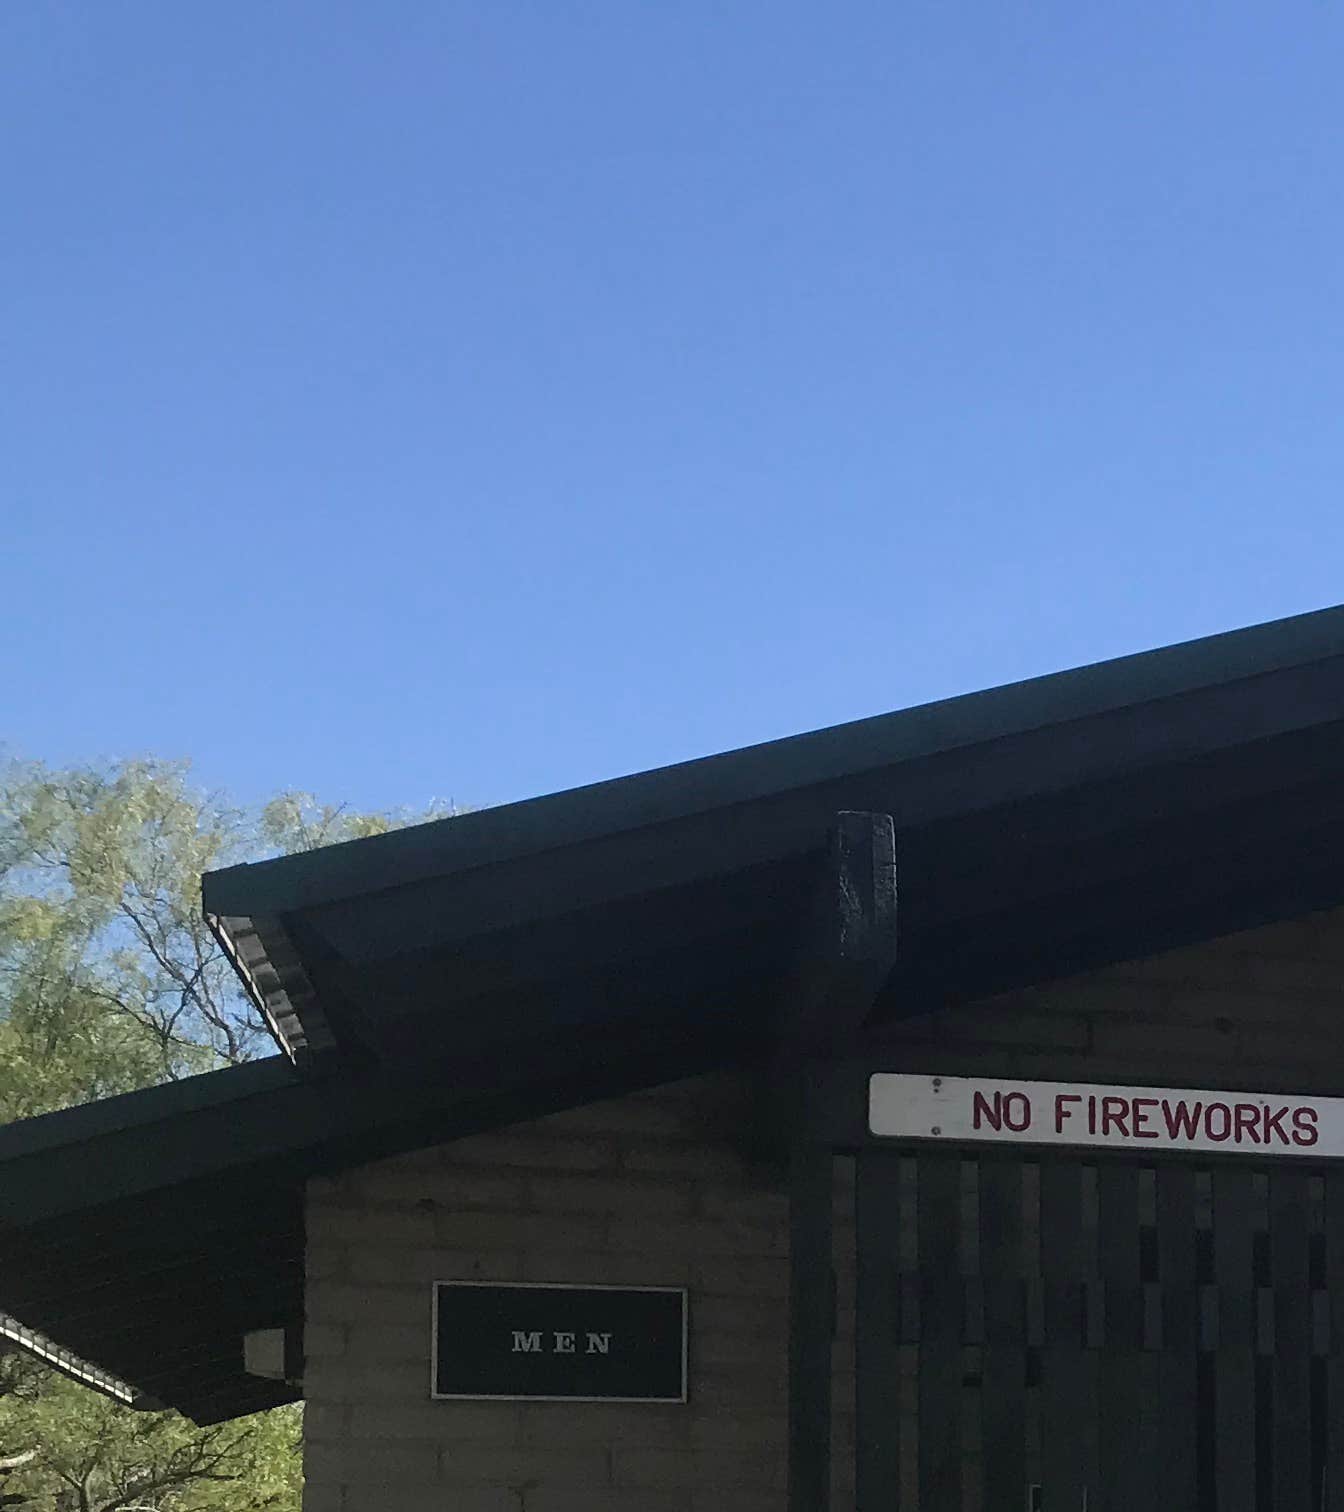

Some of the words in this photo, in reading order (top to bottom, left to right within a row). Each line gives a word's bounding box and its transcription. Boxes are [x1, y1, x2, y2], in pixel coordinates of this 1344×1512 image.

[973, 1091, 1031, 1132] NO
[1054, 1094, 1319, 1147] FIREWORKS
[511, 1330, 612, 1354] MEN
